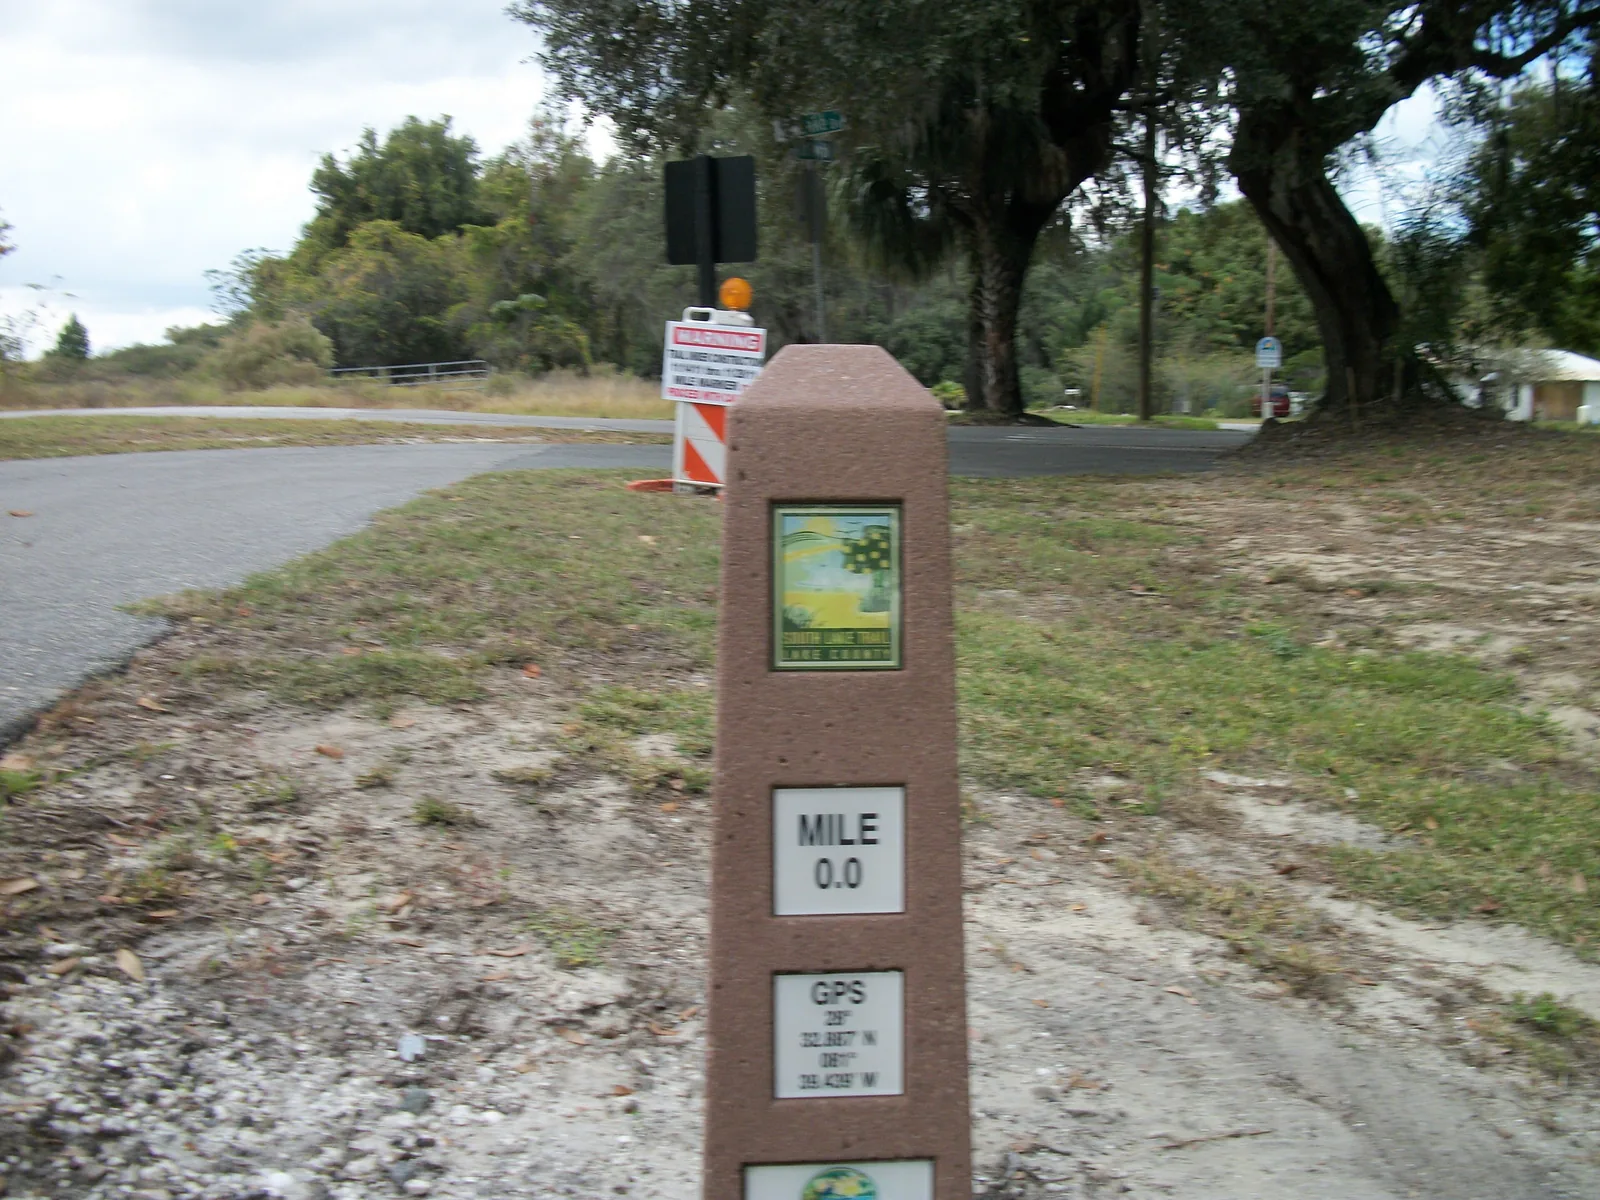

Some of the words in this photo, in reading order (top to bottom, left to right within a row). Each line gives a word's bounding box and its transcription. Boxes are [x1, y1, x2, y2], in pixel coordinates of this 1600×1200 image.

[798, 813, 879, 846] MILE
[814, 857, 861, 889] 0.0
[811, 980, 867, 1005] GPS
